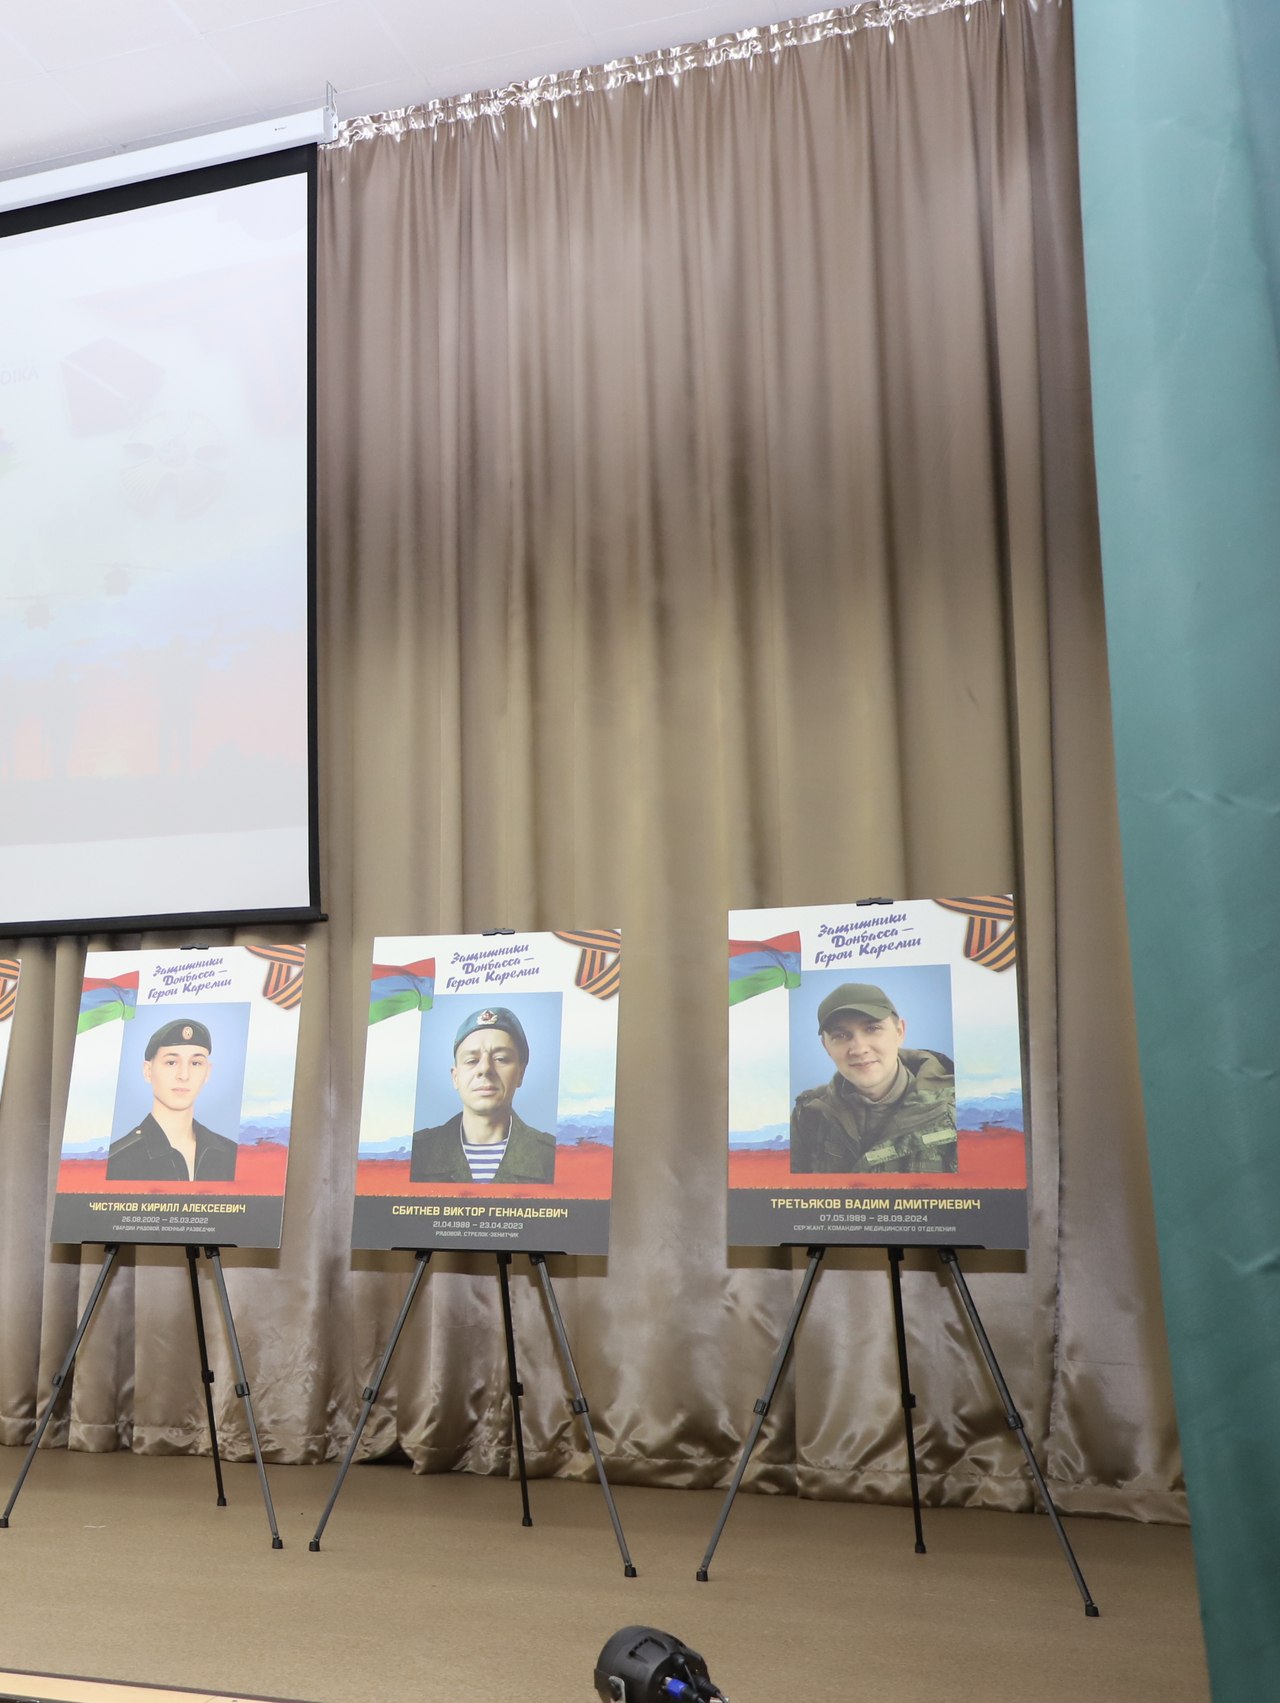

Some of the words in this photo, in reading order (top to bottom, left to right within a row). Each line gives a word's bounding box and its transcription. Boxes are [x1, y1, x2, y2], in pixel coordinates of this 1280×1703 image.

[817, 913, 907, 938] Защитники
[831, 928, 898, 948] Донбасса
[451, 944, 529, 964] Защитники
[815, 950, 852, 968] Герои
[858, 937, 921, 959] Карелии
[153, 958, 223, 977] Защитники
[462, 957, 521, 974] Донбасса
[163, 970, 215, 986] Донбасса
[446, 977, 480, 992] Герои
[485, 967, 540, 986] Карелии
[148, 988, 178, 1003] Герои
[183, 979, 231, 996] Карелии
[89, 1202, 138, 1212] ЧИСТЯКОВ
[141, 1203, 179, 1212] КИРИЛЛ
[182, 1204, 246, 1213] АЛЕКСЕЕВИЧ
[392, 1206, 440, 1216] СБИТНЕВ
[443, 1207, 485, 1216] ВИКТОР
[488, 1207, 568, 1218] ГЕННАДЬЕВИЧ
[771, 1199, 841, 1209] ТРЕТЬЯКОВ
[845, 1199, 890, 1209] ВАДИМ
[894, 1199, 981, 1209] ДМИТРИЕВИЧ
[819, 1214, 866, 1222] 07.05.1989
[877, 1214, 928, 1222] 28.09.2024
